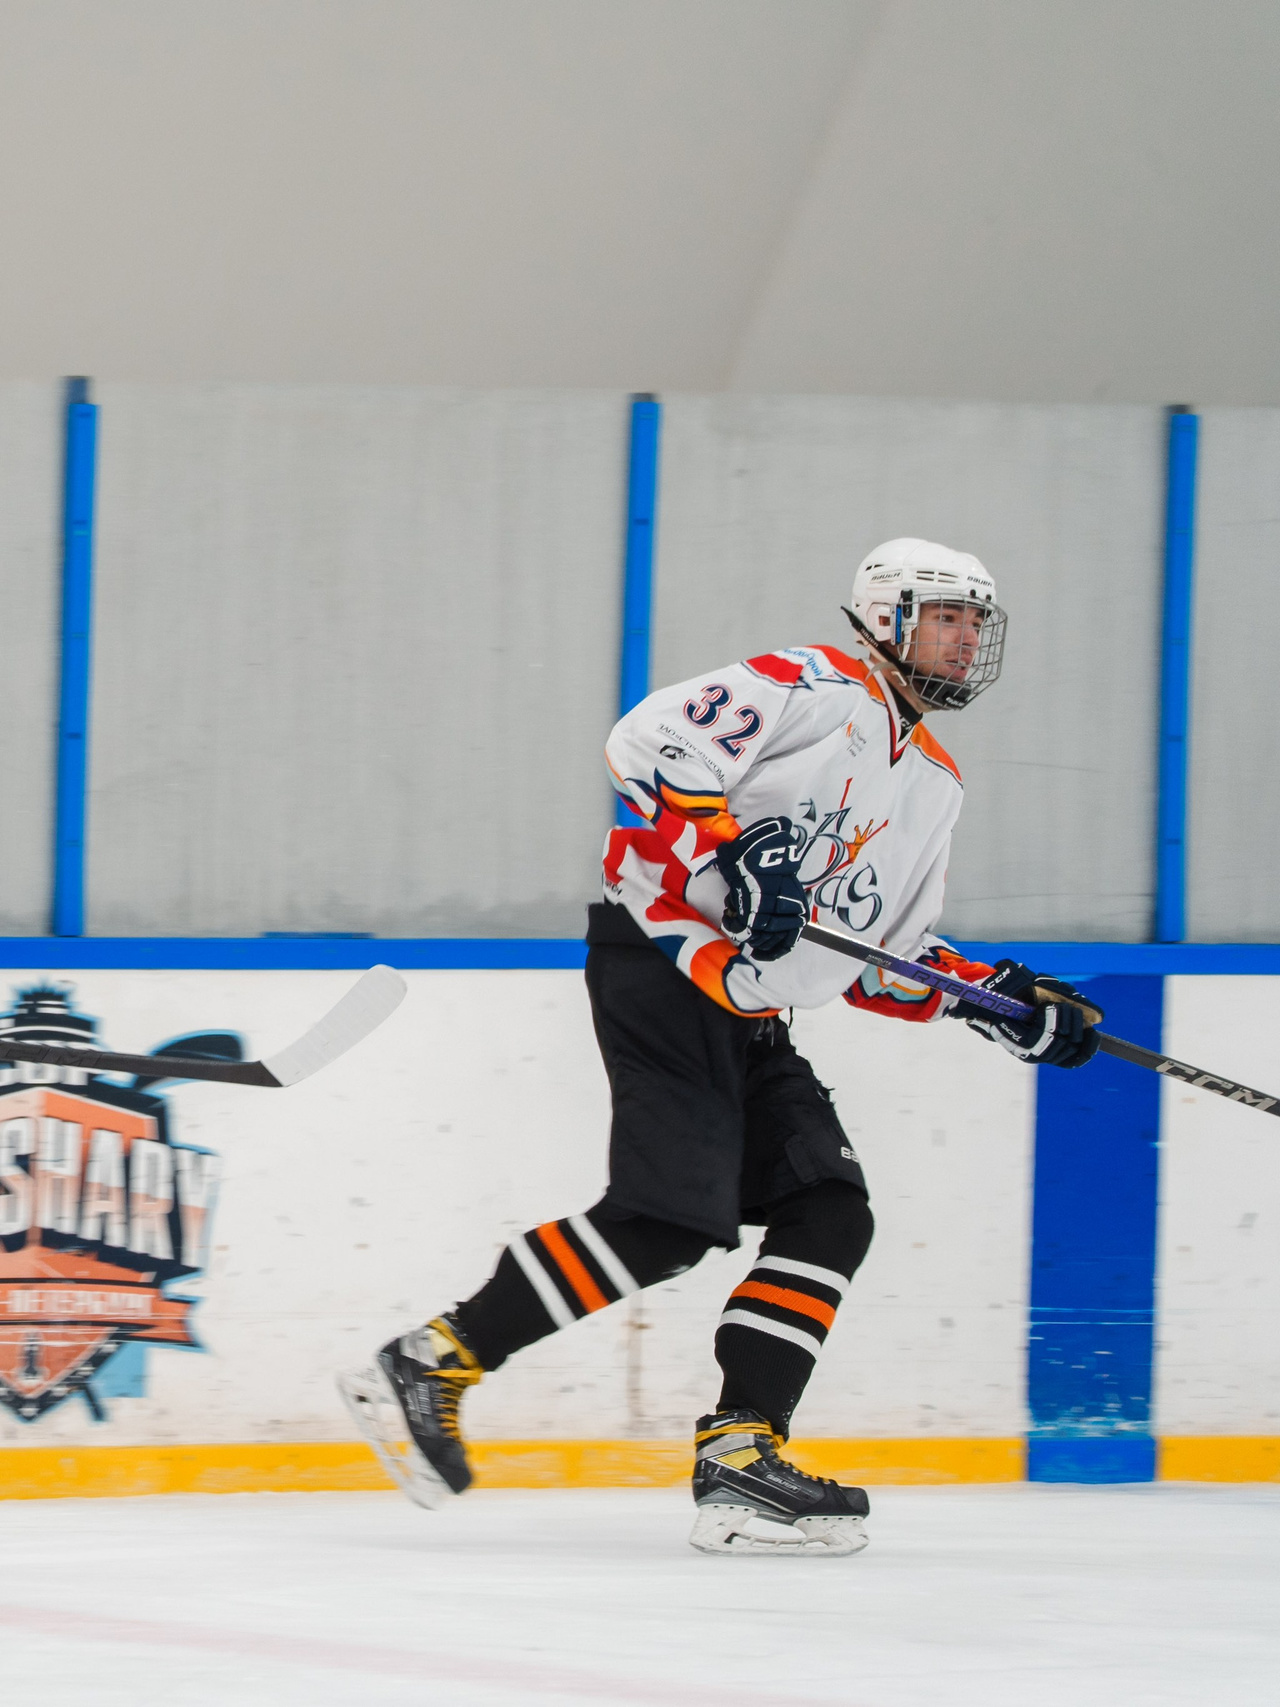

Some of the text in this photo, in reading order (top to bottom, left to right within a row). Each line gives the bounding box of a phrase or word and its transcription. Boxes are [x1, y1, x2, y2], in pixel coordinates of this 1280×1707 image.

[683, 683, 764, 762] 32
[911, 970, 1015, 1017] RIBCOR
[986, 967, 1010, 990] CCM
[1156, 1060, 1278, 1111] CCM
